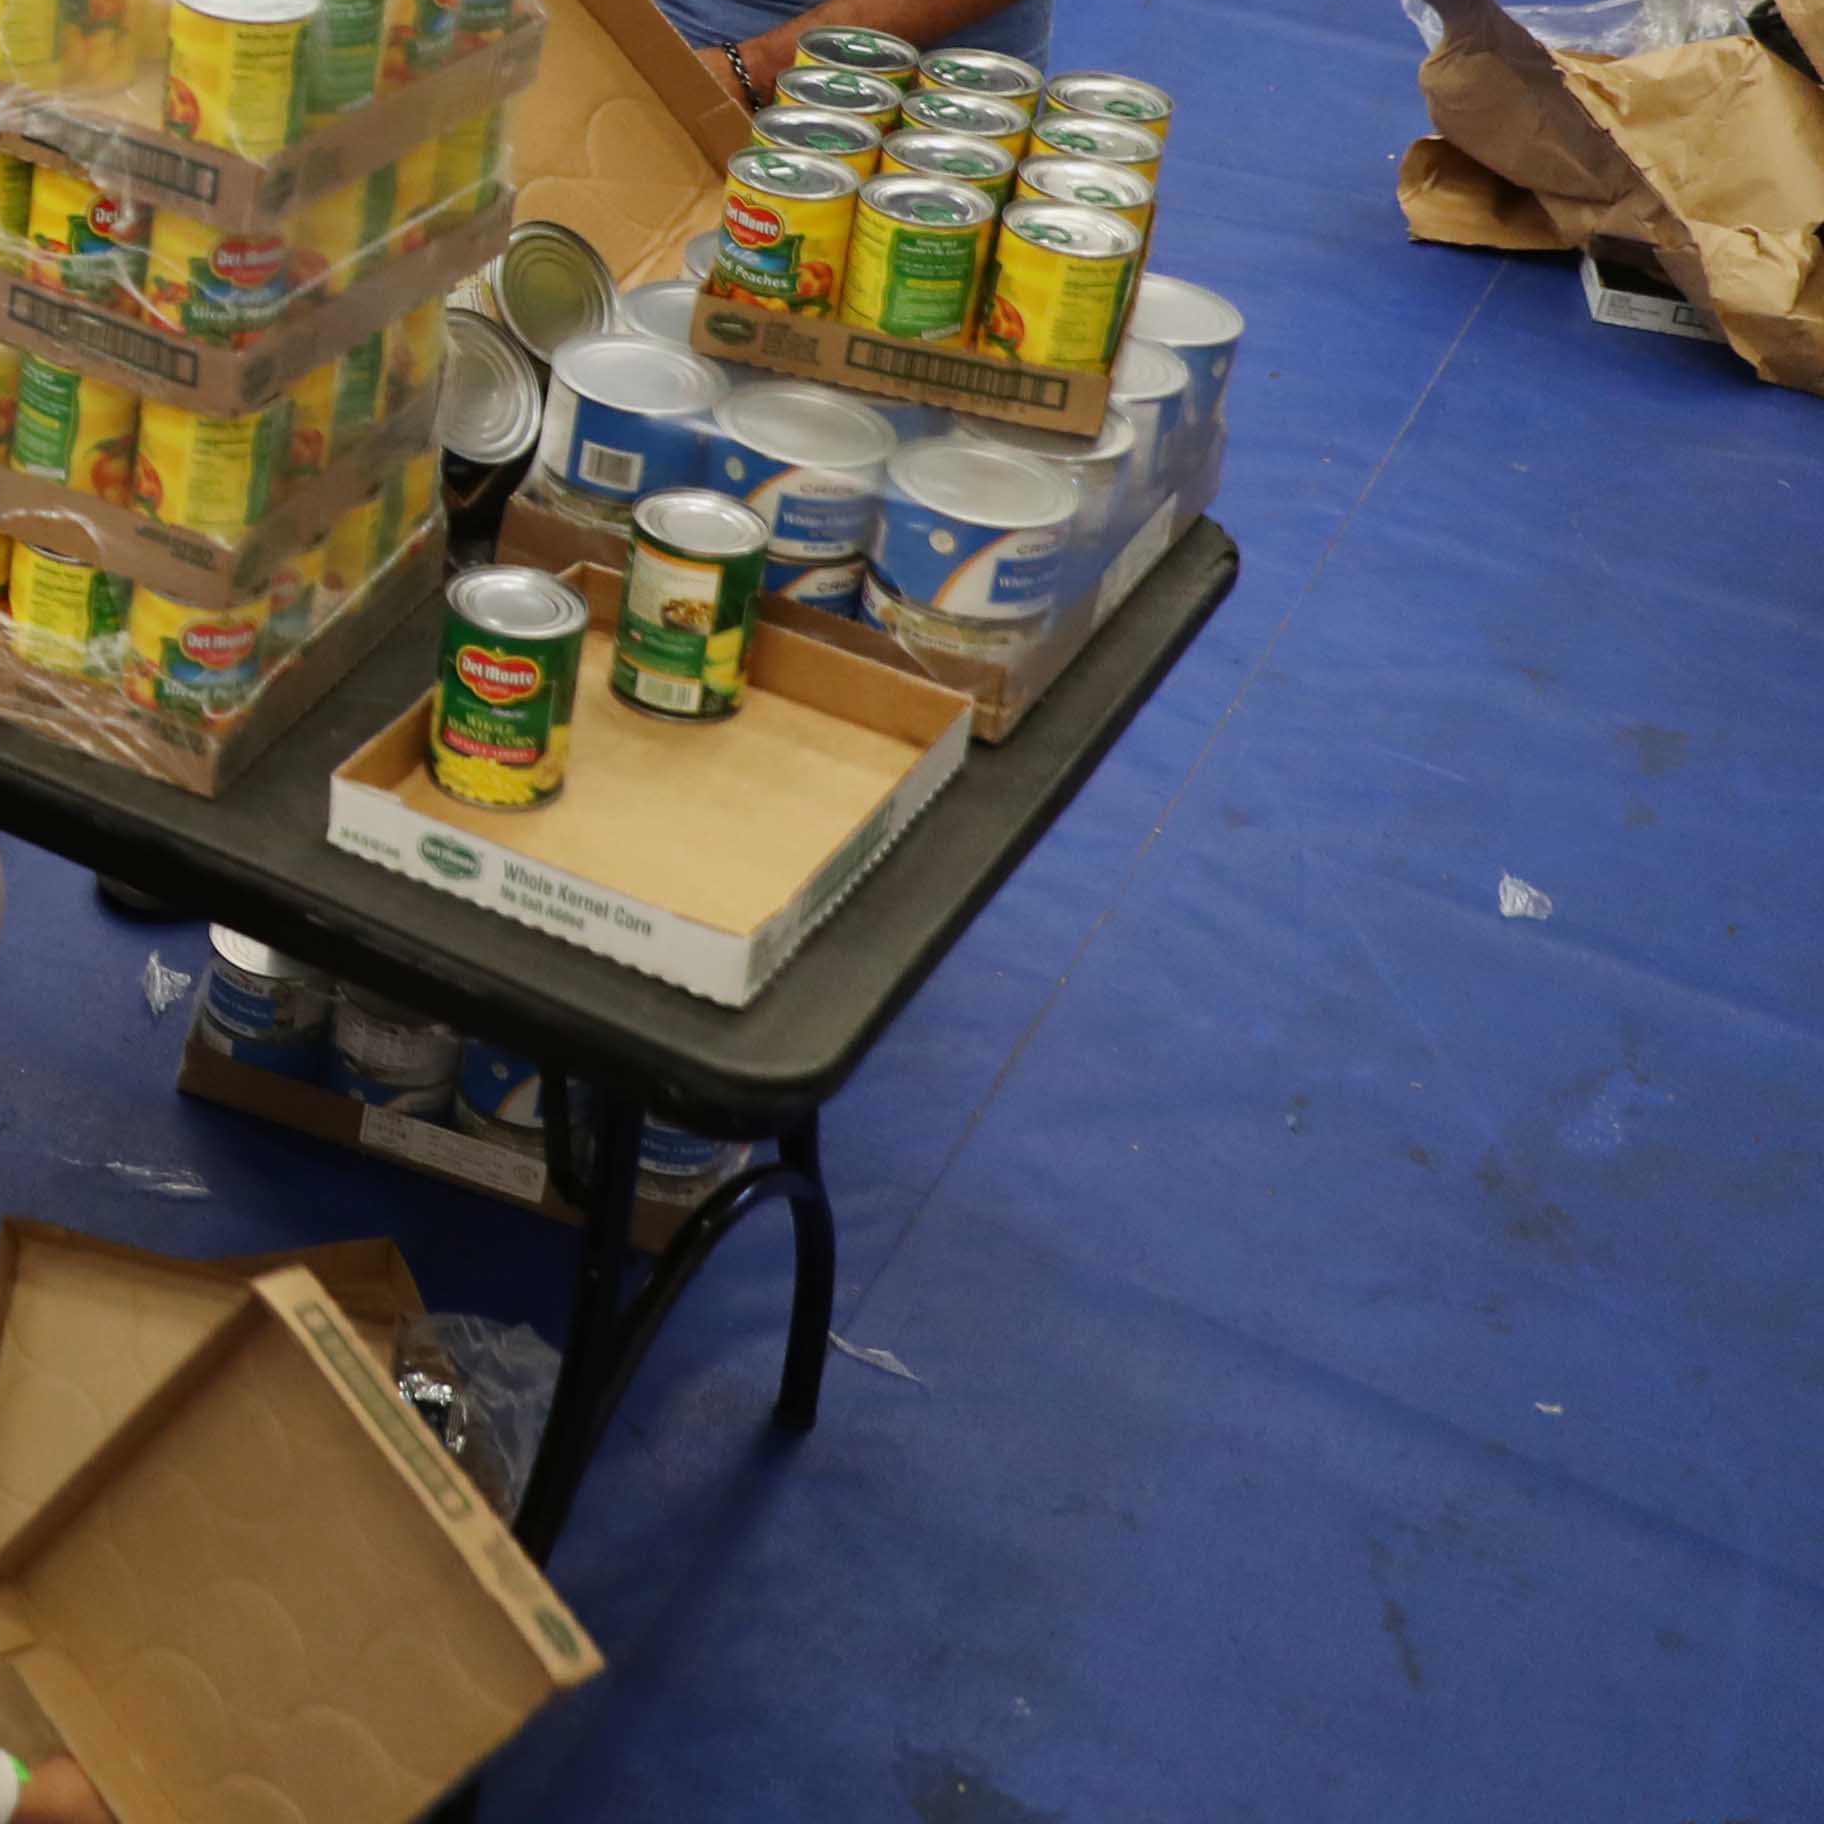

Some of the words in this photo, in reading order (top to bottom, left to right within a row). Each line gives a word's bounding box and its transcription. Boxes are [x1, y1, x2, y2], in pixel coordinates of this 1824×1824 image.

[737, 211, 778, 236] Monte
[735, 264, 790, 290] Peaches
[461, 654, 483, 674] Del
[484, 665, 534, 686] Monte
[465, 711, 517, 736] WHOLE
[495, 732, 536, 748] CORN
[501, 885, 517, 901] No
[520, 892, 544, 913] Salt
[503, 860, 553, 896] Whole
[557, 879, 611, 918] Kernel
[613, 907, 652, 937] Corn
